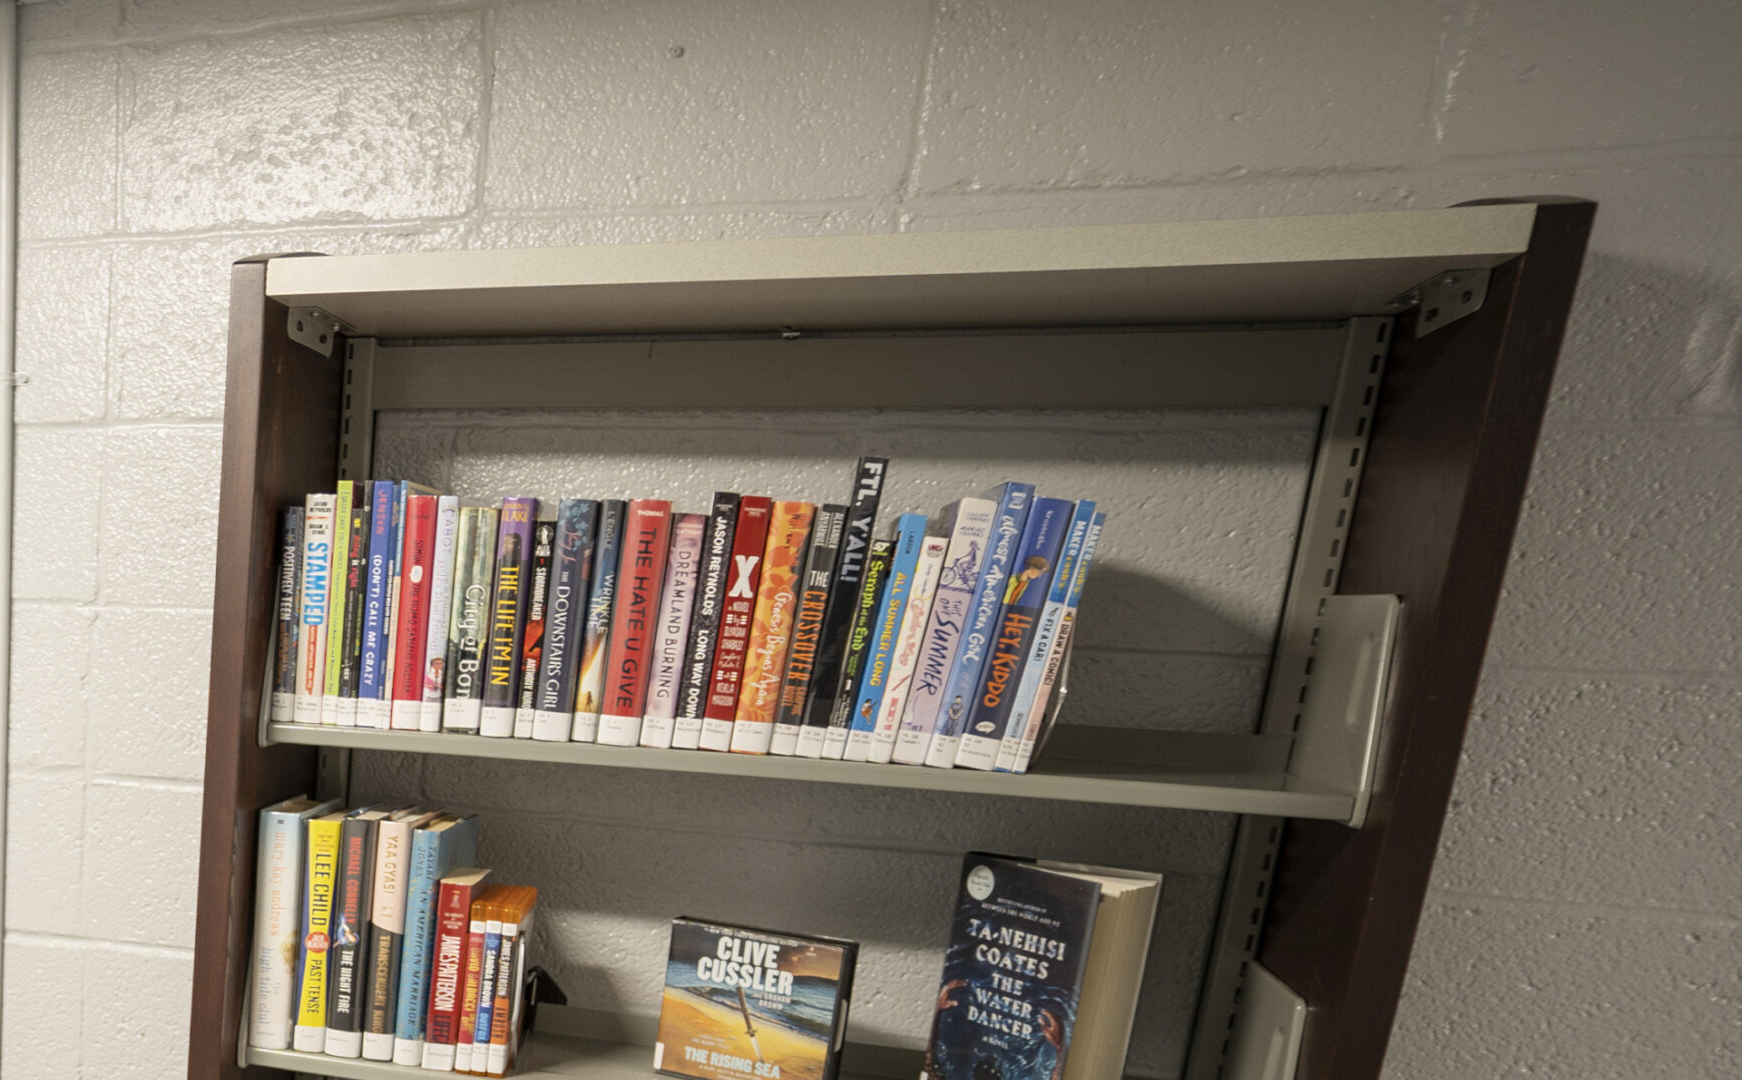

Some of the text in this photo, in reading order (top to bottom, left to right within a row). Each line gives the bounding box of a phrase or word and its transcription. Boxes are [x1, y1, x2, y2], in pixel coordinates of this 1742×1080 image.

[375, 489, 387, 535] JENSEN
[441, 508, 454, 553] CABOT
[502, 510, 529, 523] FLAKE
[637, 509, 665, 517] THOMAS
[712, 516, 729, 555] JASON
[840, 516, 872, 582] Y'ALL!
[1067, 519, 1087, 557] MAKER
[1081, 524, 1102, 561] MAKER
[279, 545, 296, 620] POSITIVELY TEEN
[304, 542, 329, 626] STAMPED
[531, 566, 547, 621] STORMBREAKER
[701, 556, 723, 616] REYNOLDS
[728, 554, 760, 599] X
[363, 554, 383, 686] (DON'T) CALL ME CRAZY
[458, 583, 487, 655] City of
[490, 566, 520, 686] THE LIFE I'M IN
[597, 574, 616, 634] WRINKLE
[616, 527, 657, 709] THE HATE U GIVE
[657, 550, 692, 699] DREAMLAND BURNING
[788, 570, 829, 681] THE CROSSOVER
[851, 560, 885, 651] Seraph End
[939, 598, 951, 615] ONE
[951, 599, 963, 617] THIS
[1042, 618, 1055, 633] FIX
[547, 586, 571, 677] DOWNSTAIRS
[694, 629, 710, 661] LONG
[750, 592, 793, 705] Genesis Begins Again
[869, 571, 907, 687] ALL SUMMER LONG
[1055, 623, 1072, 649] DRAW
[689, 662, 704, 687] WAY
[916, 611, 960, 696] SUMMER
[982, 612, 1033, 708] HEY, KIDDO
[542, 679, 560, 709] GIRL
[684, 687, 701, 719] DOWN
[269, 832, 288, 936] mary kay andrews
[314, 853, 332, 880] LEE
[382, 835, 399, 895] YAA GYASI
[415, 847, 427, 877] JONES
[311, 883, 330, 927] CHILD
[336, 836, 363, 1014] MICHAEL CONNELLY THE NIGHT FIRE
[407, 888, 429, 1026] AN AMERICAN MARRIAGE
[441, 933, 462, 963] JAMES
[716, 936, 781, 969] CLIVE
[968, 918, 1067, 961] TA-NEHISI
[309, 958, 323, 983] PAST
[374, 935, 391, 1007] TRANSCENDENT
[484, 949, 497, 981] SANDRA
[696, 956, 795, 996] CUSSLER
[975, 943, 1050, 981] COATES
[991, 972, 1024, 996] THE
[306, 986, 321, 1015] TENSE
[434, 962, 460, 1012] PATTERSON
[480, 981, 493, 1008] BROWN
[492, 940, 512, 1040] JAMES PATTERSON AMBUSH
[976, 987, 1033, 1020] WATER
[967, 1005, 1033, 1041] DANCER
[684, 1045, 708, 1063] THE
[710, 1052, 753, 1073] RISING
[754, 1061, 781, 1079] SEA
